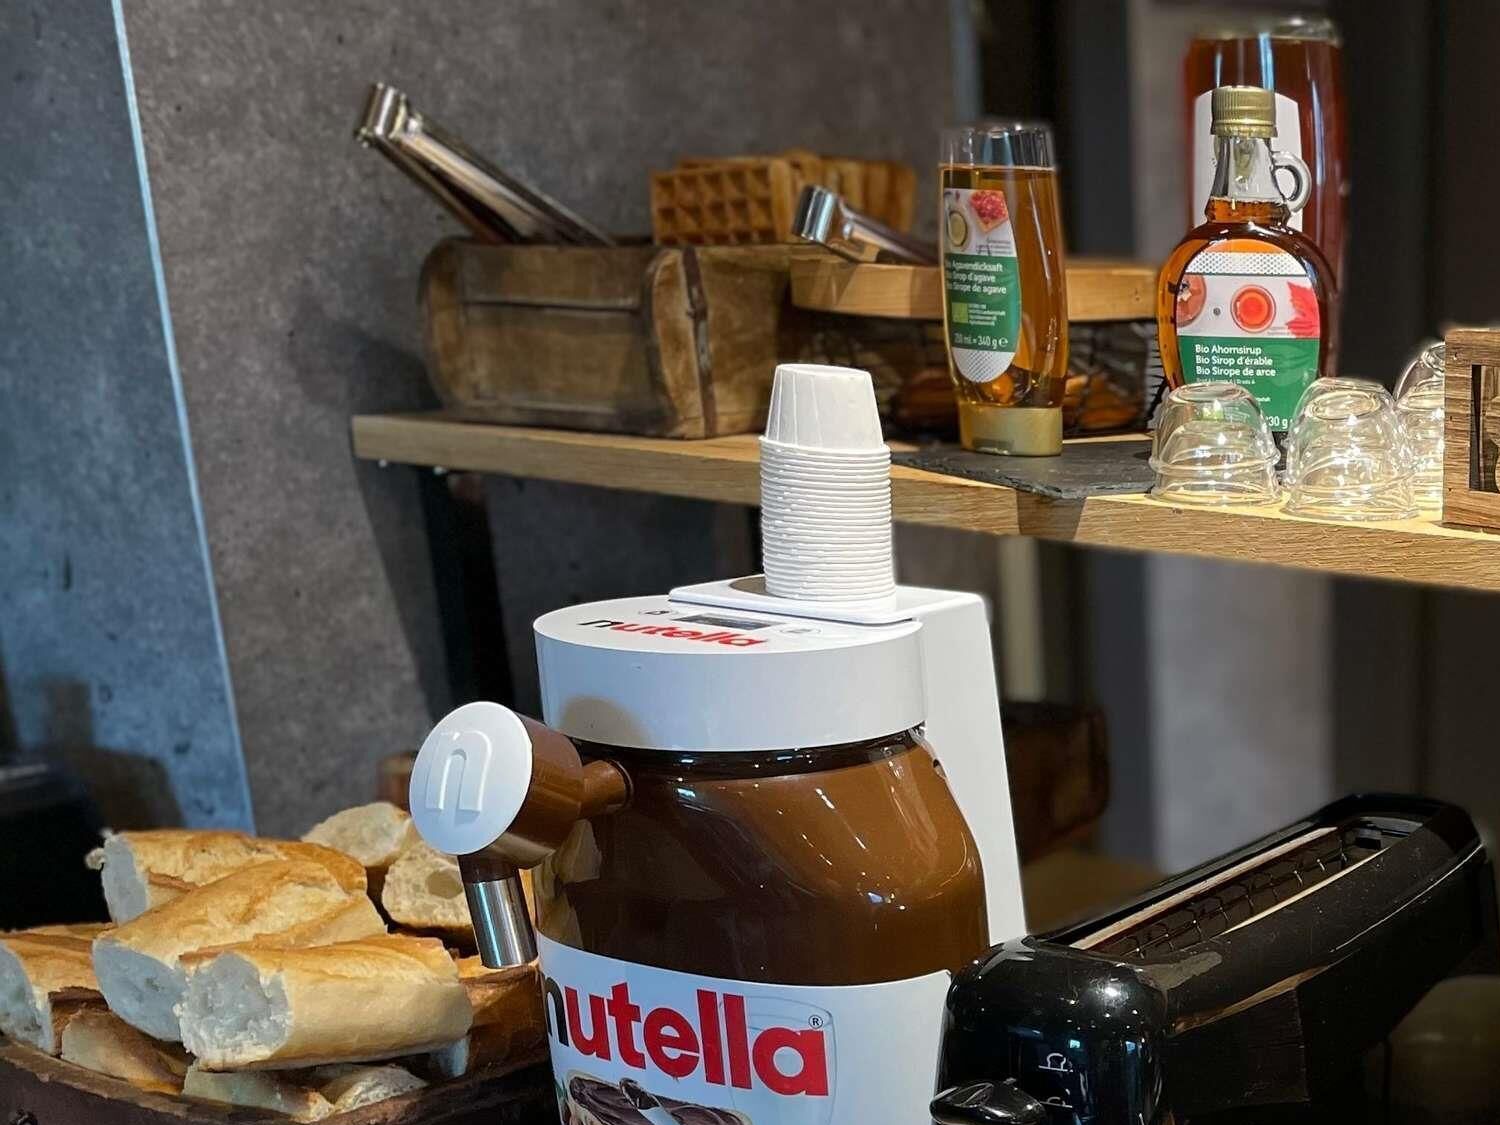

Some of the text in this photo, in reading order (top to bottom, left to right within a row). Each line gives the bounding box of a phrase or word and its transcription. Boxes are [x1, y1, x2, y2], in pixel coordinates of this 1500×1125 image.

[1194, 344, 1262, 356] Bio Ahornsirup
[1195, 355, 1210, 365] Bio
[1211, 355, 1236, 367] Sirop
[1195, 366, 1277, 377] Bio Sirope de arce
[577, 618, 769, 648] nutella
